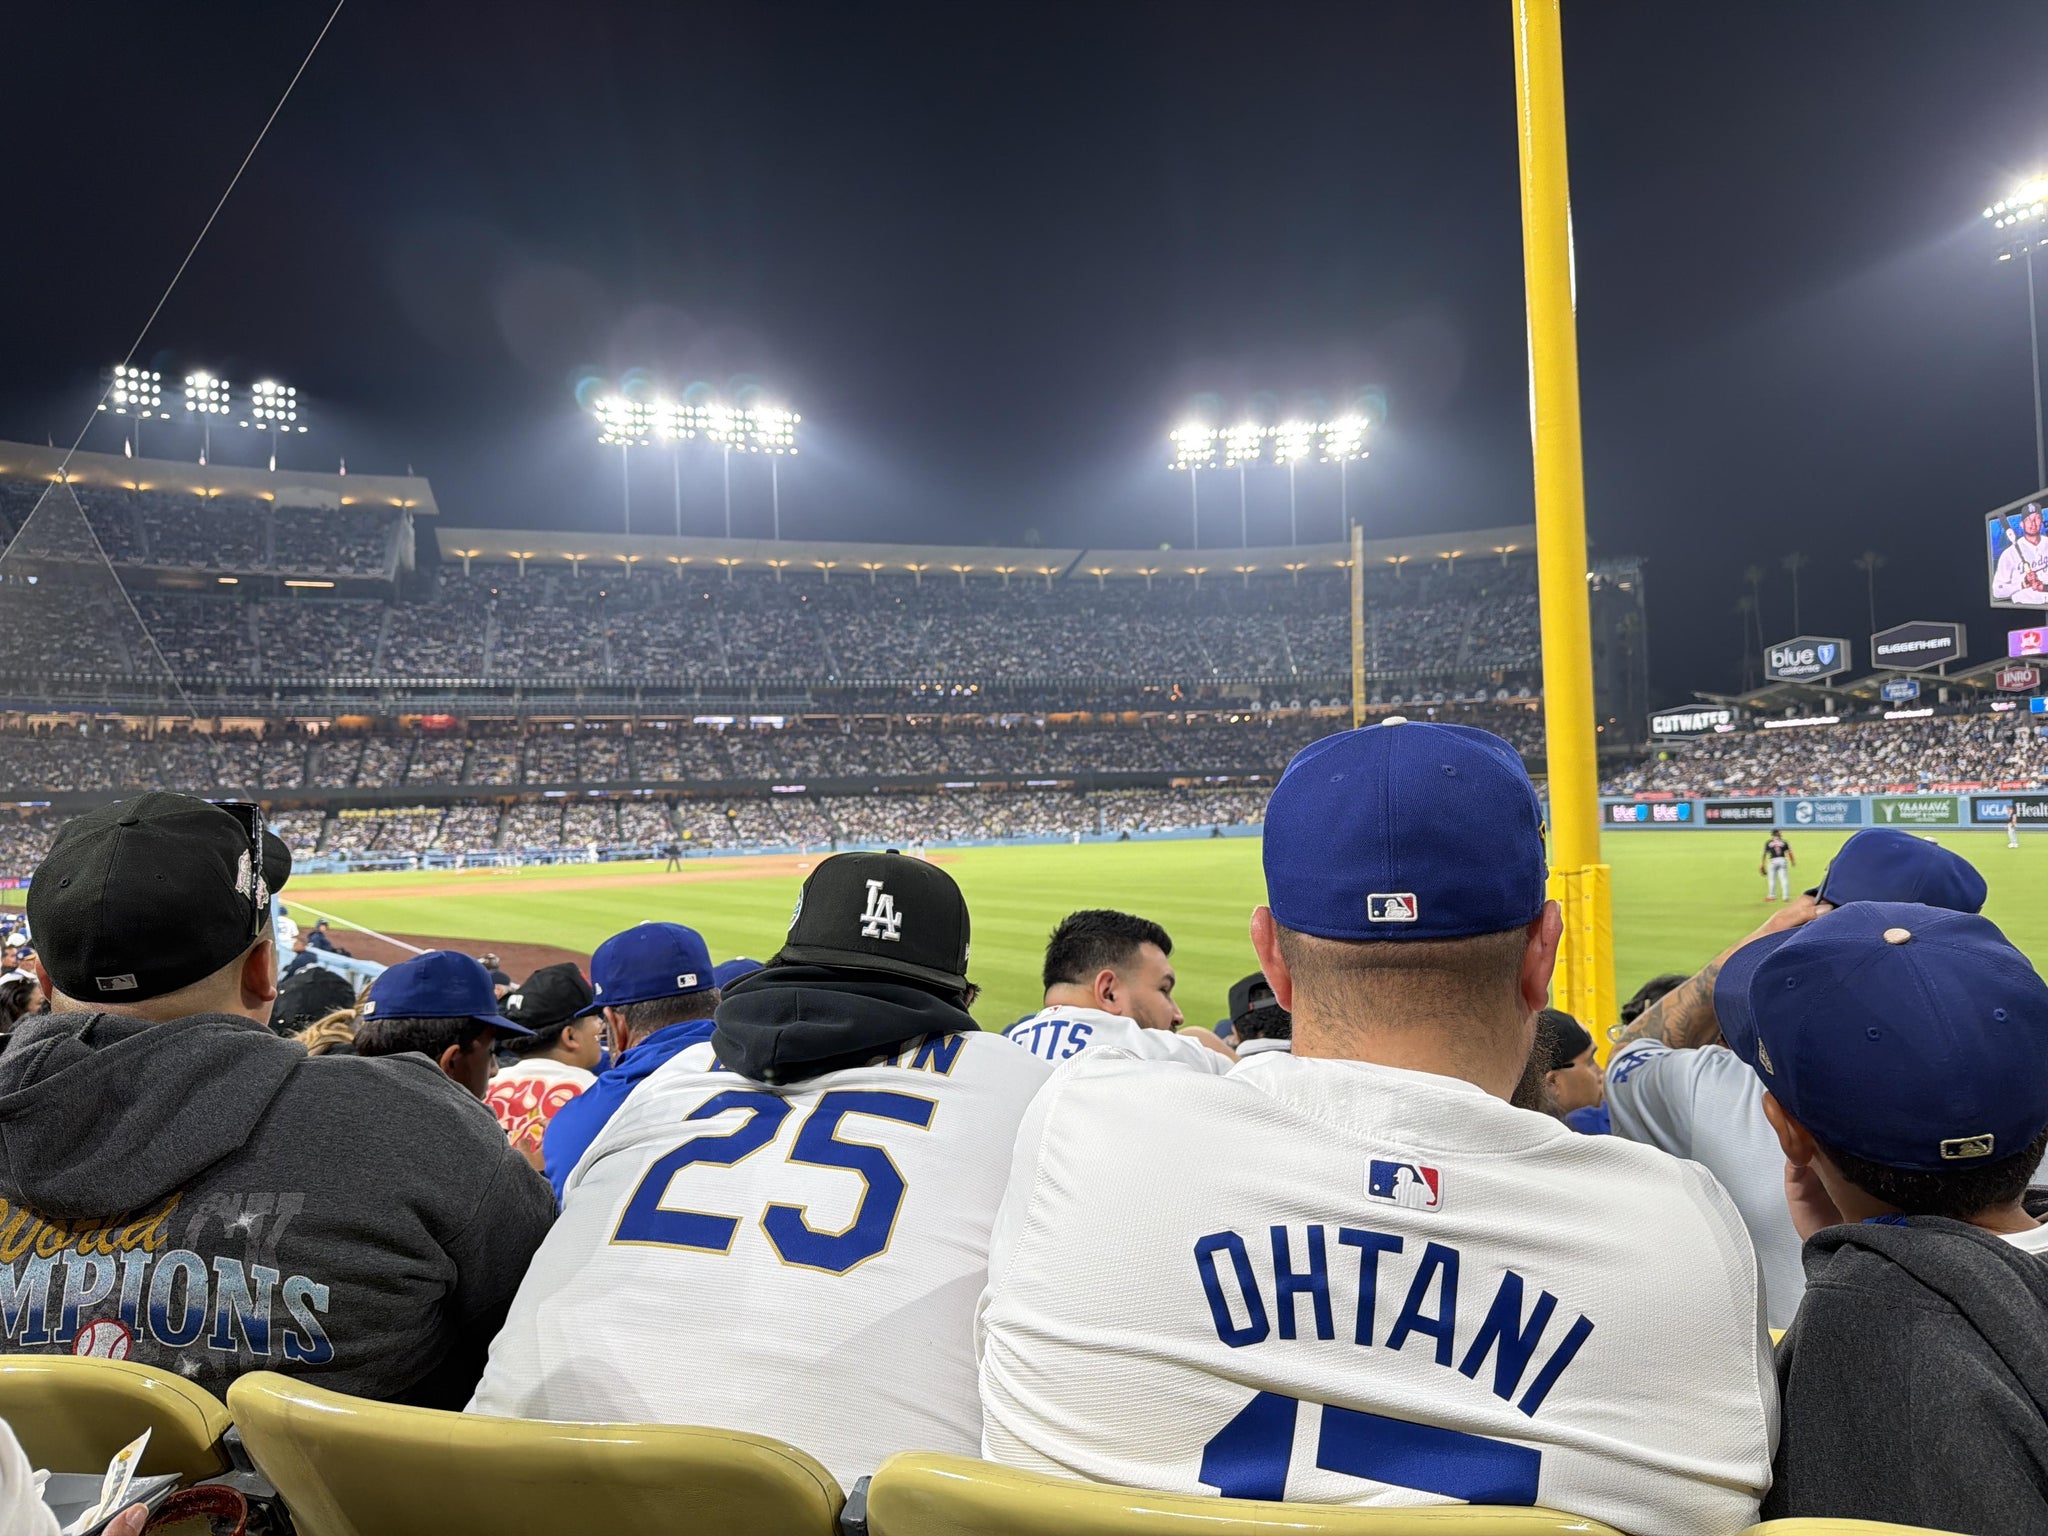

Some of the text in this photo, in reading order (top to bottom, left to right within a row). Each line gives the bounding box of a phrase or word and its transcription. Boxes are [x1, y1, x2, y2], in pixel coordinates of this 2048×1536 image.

[1771, 647, 1815, 668] blue
[2003, 670, 2032, 687] JINRO
[1981, 804, 2009, 817] UCLA
[860, 879, 902, 942] LA
[609, 1089, 940, 1277] 25
[1193, 1225, 1596, 1418] OHTANI
